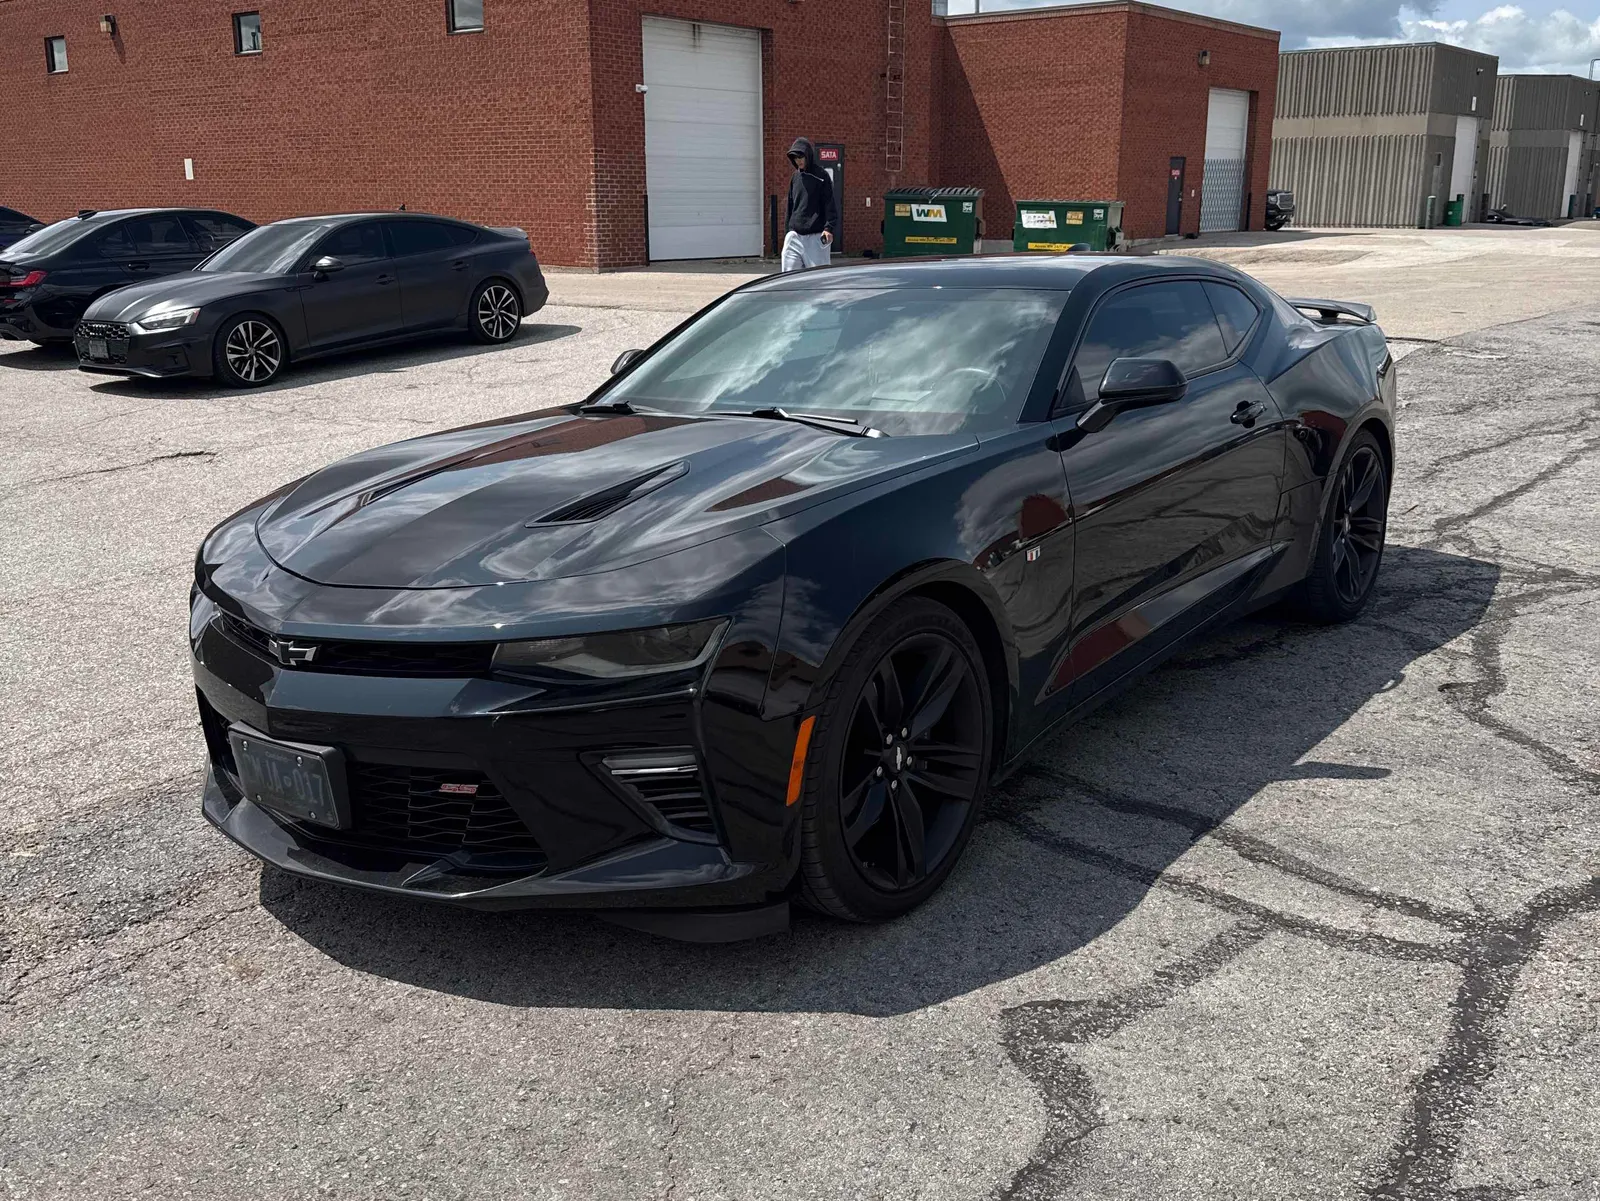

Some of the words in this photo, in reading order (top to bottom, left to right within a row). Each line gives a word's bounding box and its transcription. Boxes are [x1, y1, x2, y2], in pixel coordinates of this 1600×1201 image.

[821, 151, 837, 159] SATA
[916, 208, 943, 218] WM
[292, 767, 324, 807] 017
[439, 783, 479, 794] SS
